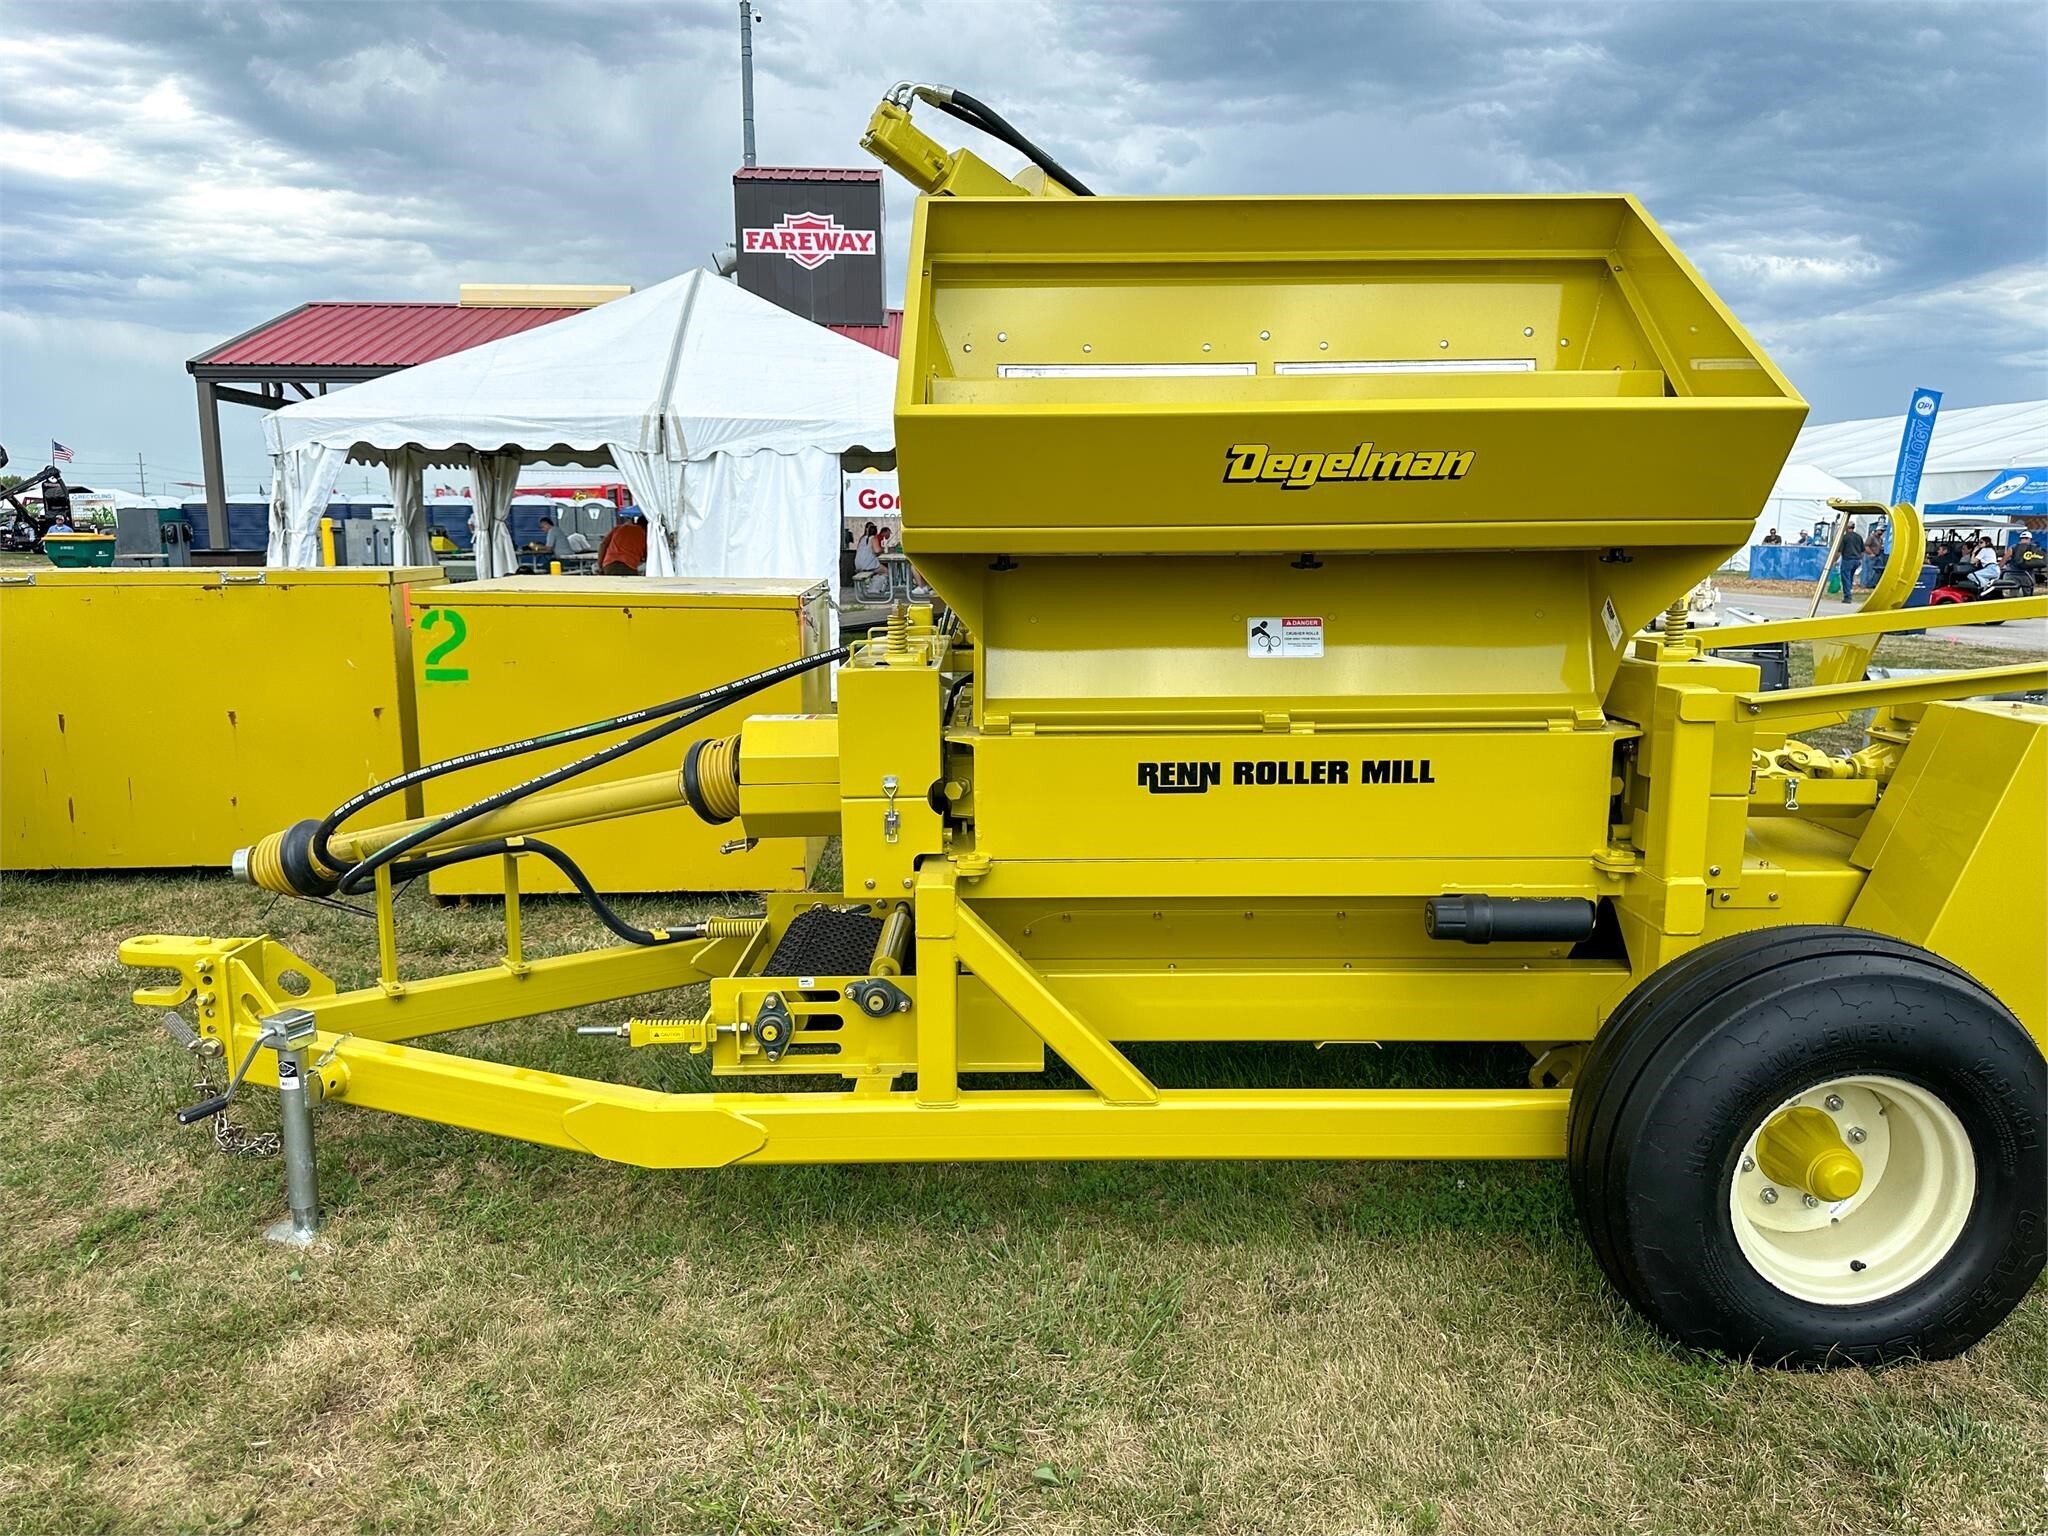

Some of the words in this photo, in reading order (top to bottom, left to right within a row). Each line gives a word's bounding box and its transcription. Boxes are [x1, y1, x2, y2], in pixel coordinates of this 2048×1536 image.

[745, 231, 873, 252] FAREWAY
[1917, 401, 1933, 411] OPI
[1223, 442, 1475, 490] Degelman
[420, 610, 469, 682] 2
[1138, 761, 1221, 794] RENN
[1233, 760, 1349, 785] ROLLER
[1361, 759, 1435, 784] MILL
